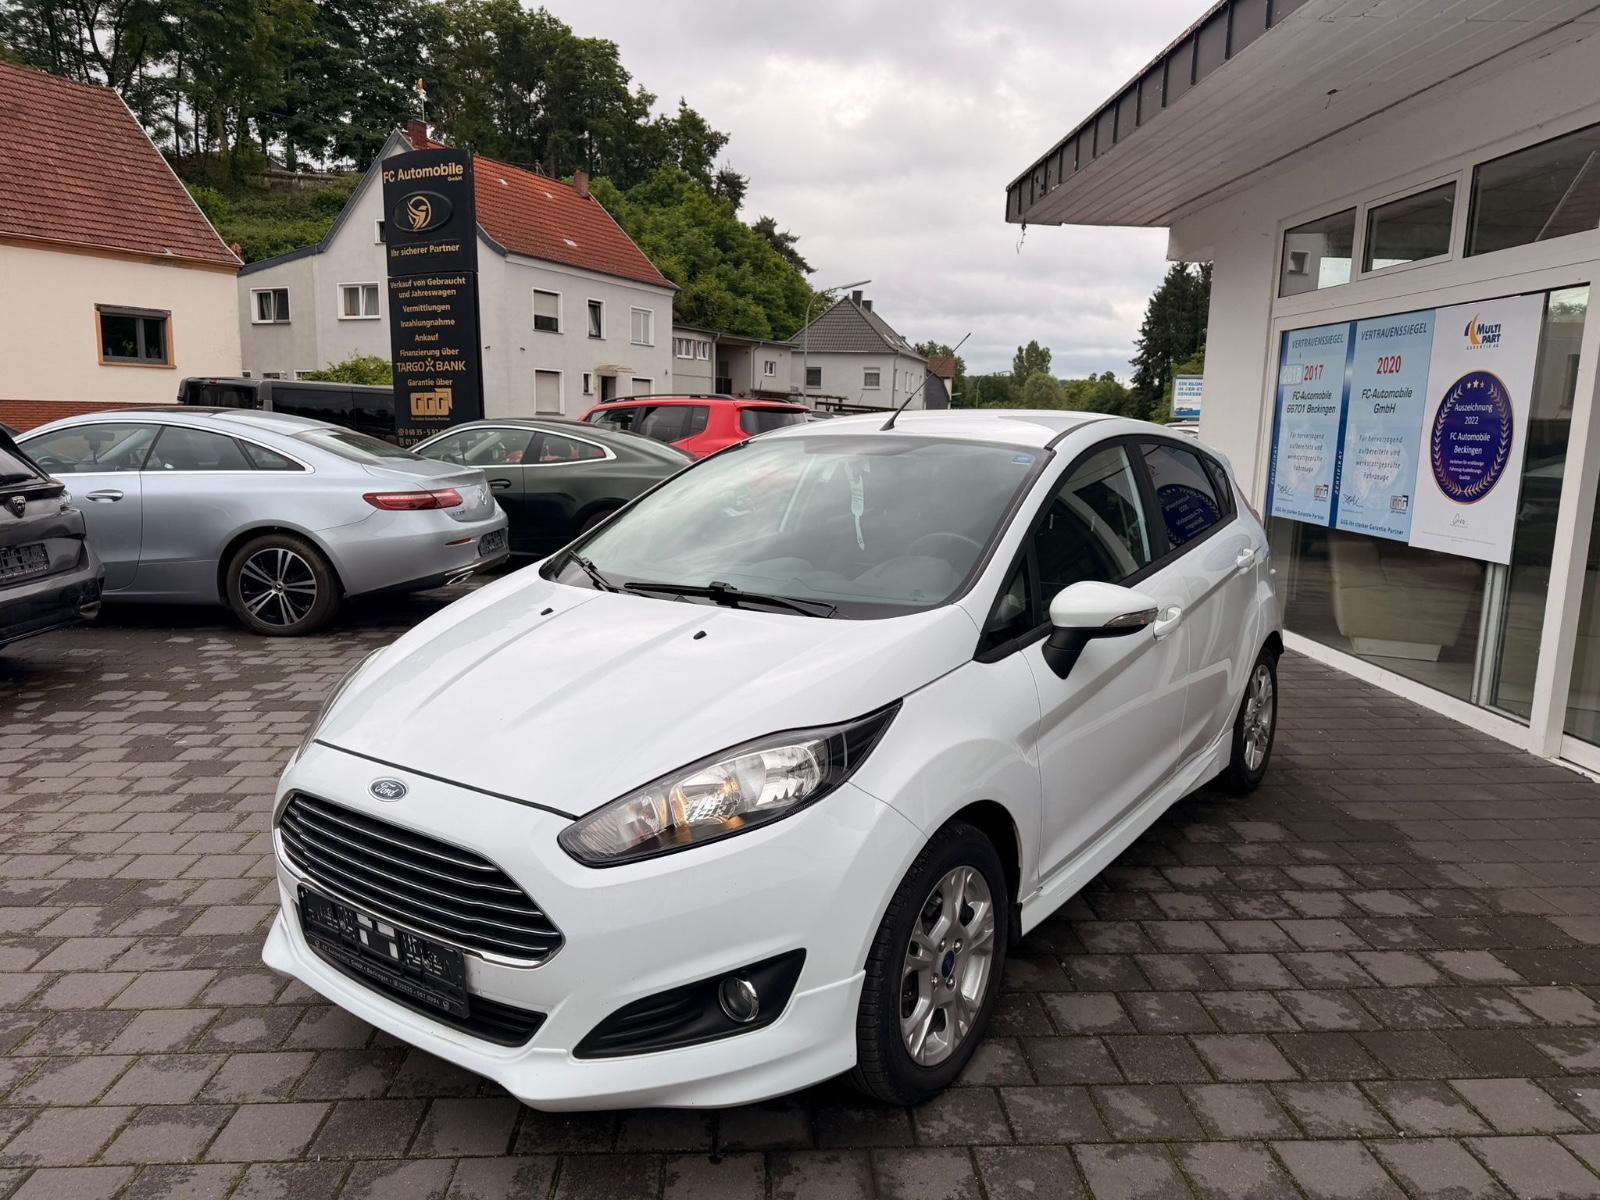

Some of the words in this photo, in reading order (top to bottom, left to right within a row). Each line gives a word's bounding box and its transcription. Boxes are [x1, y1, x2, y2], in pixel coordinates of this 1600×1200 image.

[383, 170, 395, 184] FC
[398, 162, 464, 181] Automobile
[390, 248, 400, 258] Ihr
[400, 246, 428, 256] sicherer
[429, 244, 460, 253] Partner
[390, 280, 412, 289] Verkauf
[426, 276, 466, 286] Gebraucht
[411, 288, 456, 298] Jahreswagen
[402, 304, 450, 313] Vermittlungen
[400, 318, 456, 328] Inzahlungnahme
[1361, 322, 1427, 340] VERTRAUENSSIEGEL
[414, 333, 438, 342] Ankauf
[1292, 334, 1344, 348] VERTRAUENSSIEGEL
[400, 348, 440, 358] Finanzierung
[441, 348, 460, 356] über
[1376, 354, 1402, 375] 2020
[1304, 364, 1324, 381] 2017
[408, 378, 434, 386] Garantie
[436, 378, 453, 386] über
[1362, 387, 1413, 399] FC-Automobile
[1306, 403, 1336, 416] Beckingen
[1374, 403, 1396, 414] GmbH
[1454, 403, 1493, 414] Auszeichnung
[1464, 416, 1479, 425] 2022
[1450, 432, 1457, 441] FC
[1458, 432, 1490, 442] Automobile
[1454, 445, 1482, 456] Beckingen
